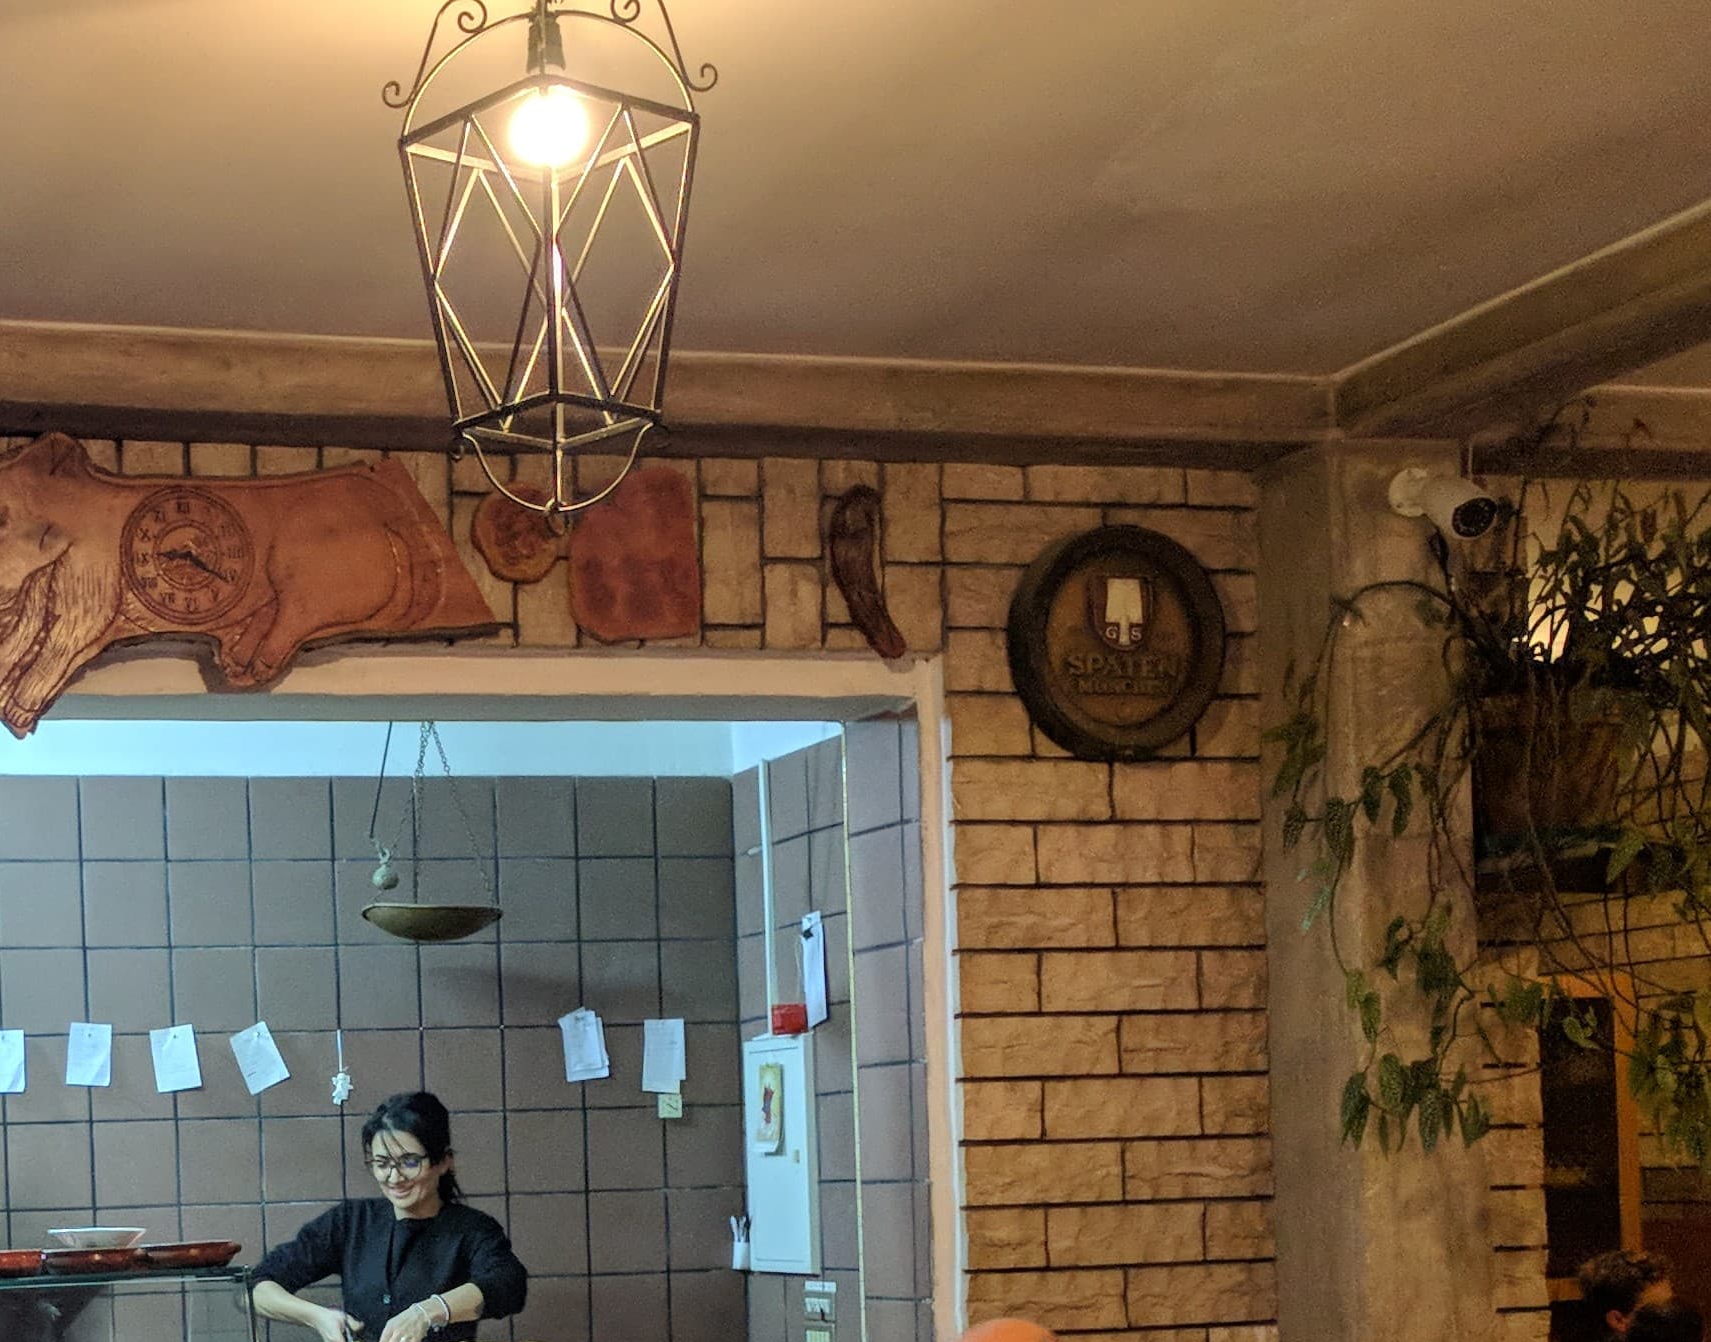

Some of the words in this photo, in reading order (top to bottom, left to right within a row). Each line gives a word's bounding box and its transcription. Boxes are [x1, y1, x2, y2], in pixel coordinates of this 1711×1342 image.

[1105, 625, 1118, 640] G
[1131, 627, 1143, 642] S
[1066, 652, 1178, 677] SPATEN
